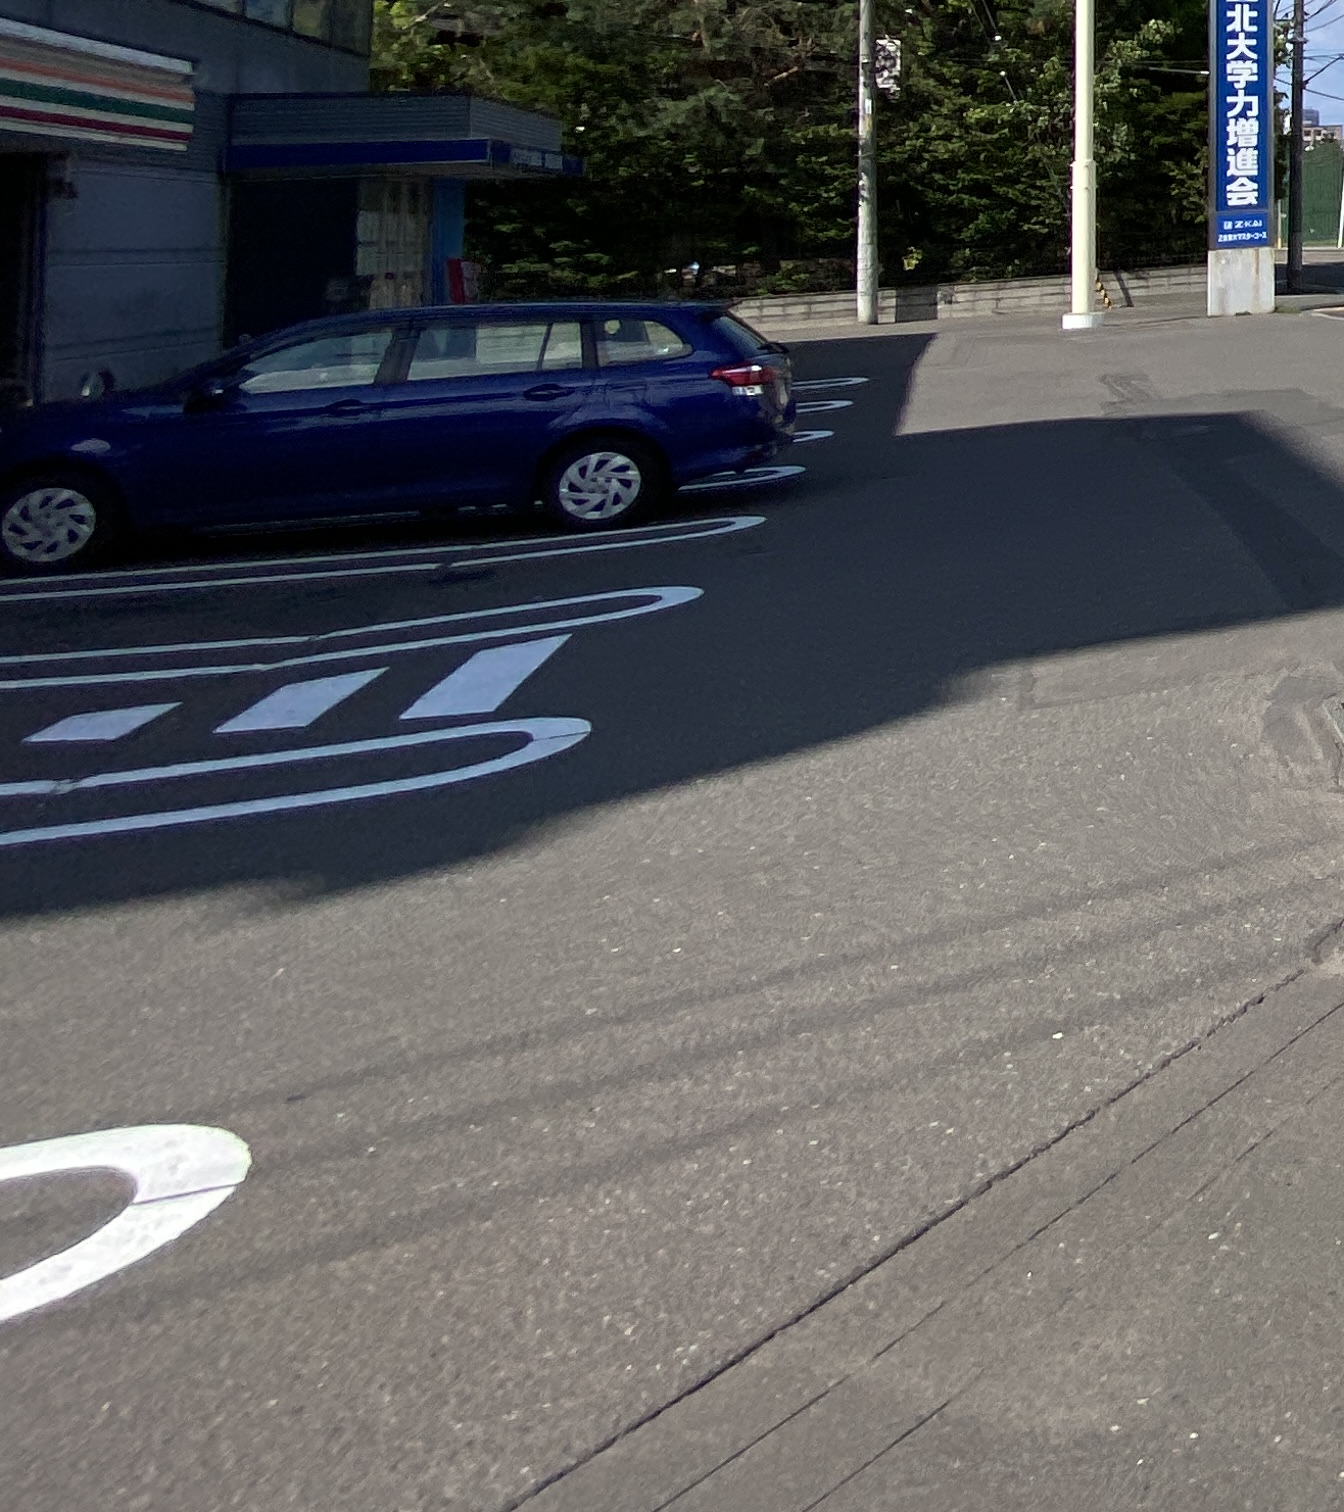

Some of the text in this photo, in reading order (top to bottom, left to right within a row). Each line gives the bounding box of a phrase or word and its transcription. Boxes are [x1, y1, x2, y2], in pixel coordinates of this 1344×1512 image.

[1226, 3, 1258, 206] 北大学力増進会
